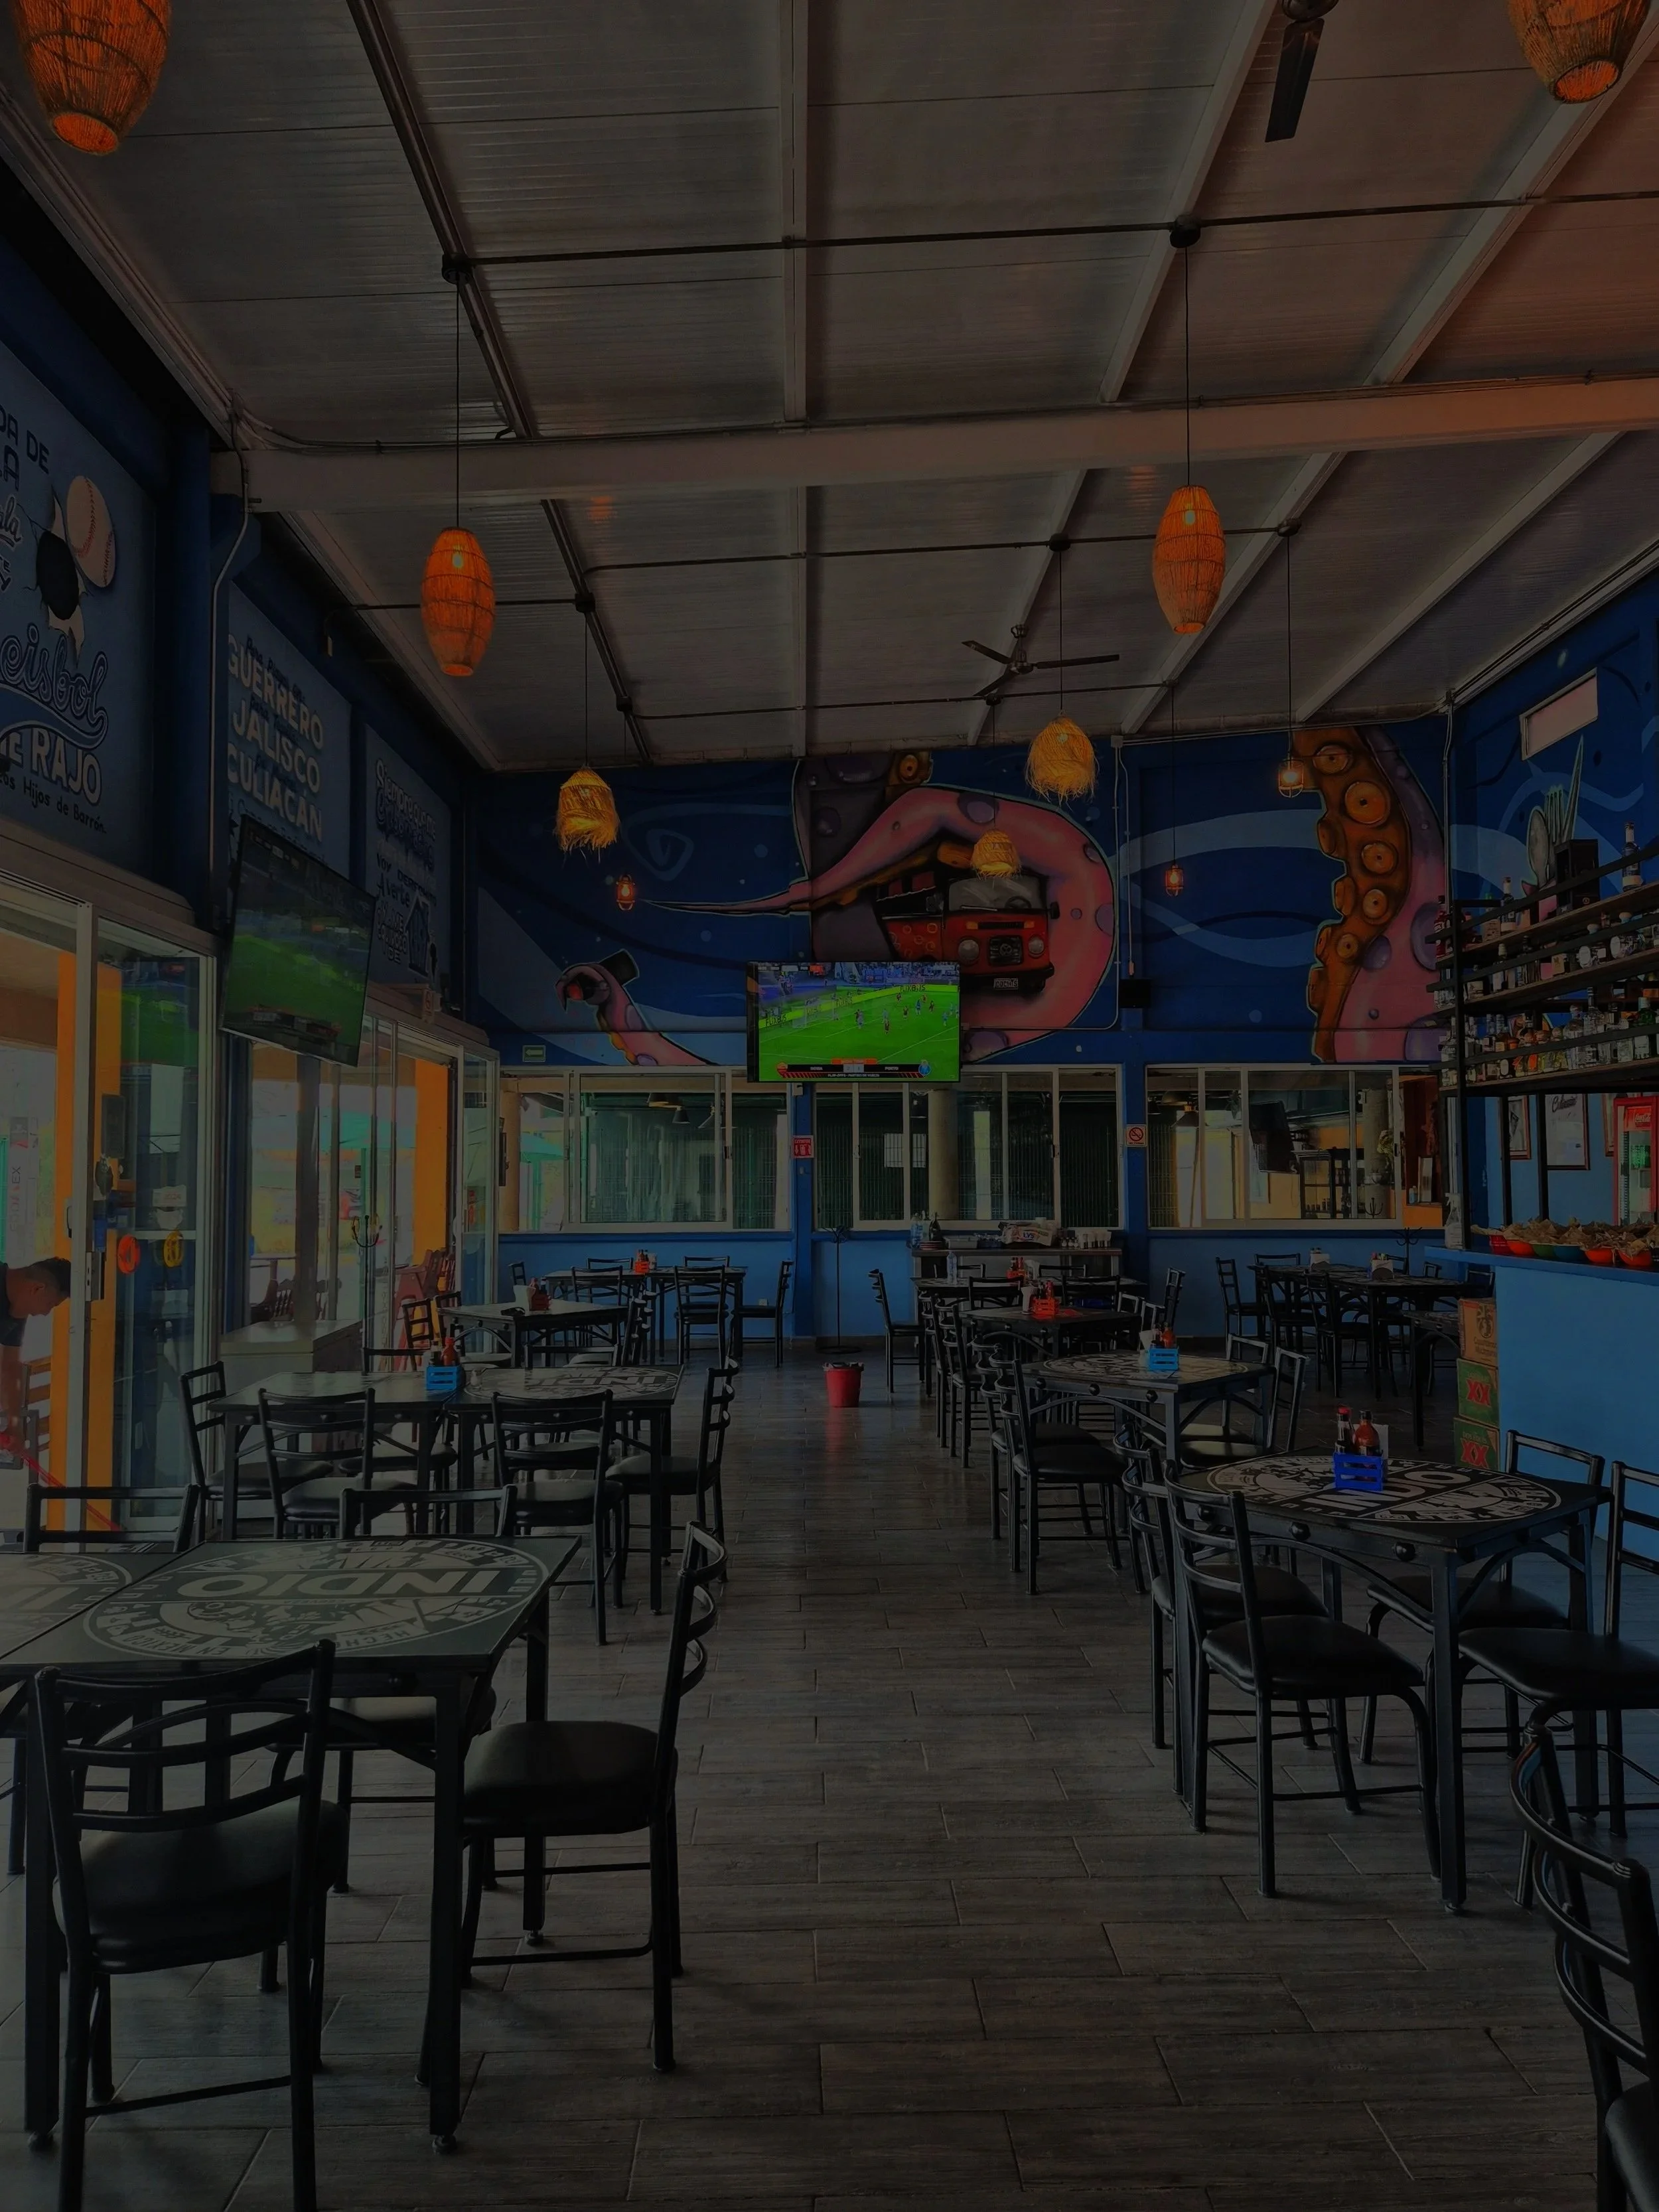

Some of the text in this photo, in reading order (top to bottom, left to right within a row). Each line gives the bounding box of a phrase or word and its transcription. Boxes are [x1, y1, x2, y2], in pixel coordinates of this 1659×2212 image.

[27, 429, 49, 475] DE
[228, 634, 324, 750] GUERRERO
[31, 728, 102, 806] RAJO
[233, 699, 321, 793] JALISCO
[23, 776, 50, 808] Hijos
[56, 794, 68, 815] de
[228, 742, 322, 843] CULIACÁN
[1466, 1378, 1491, 1408] XX
[1461, 1438, 1489, 1469] XX
[177, 1570, 500, 1597] INDIO
[335, 1628, 411, 1649] HECH
